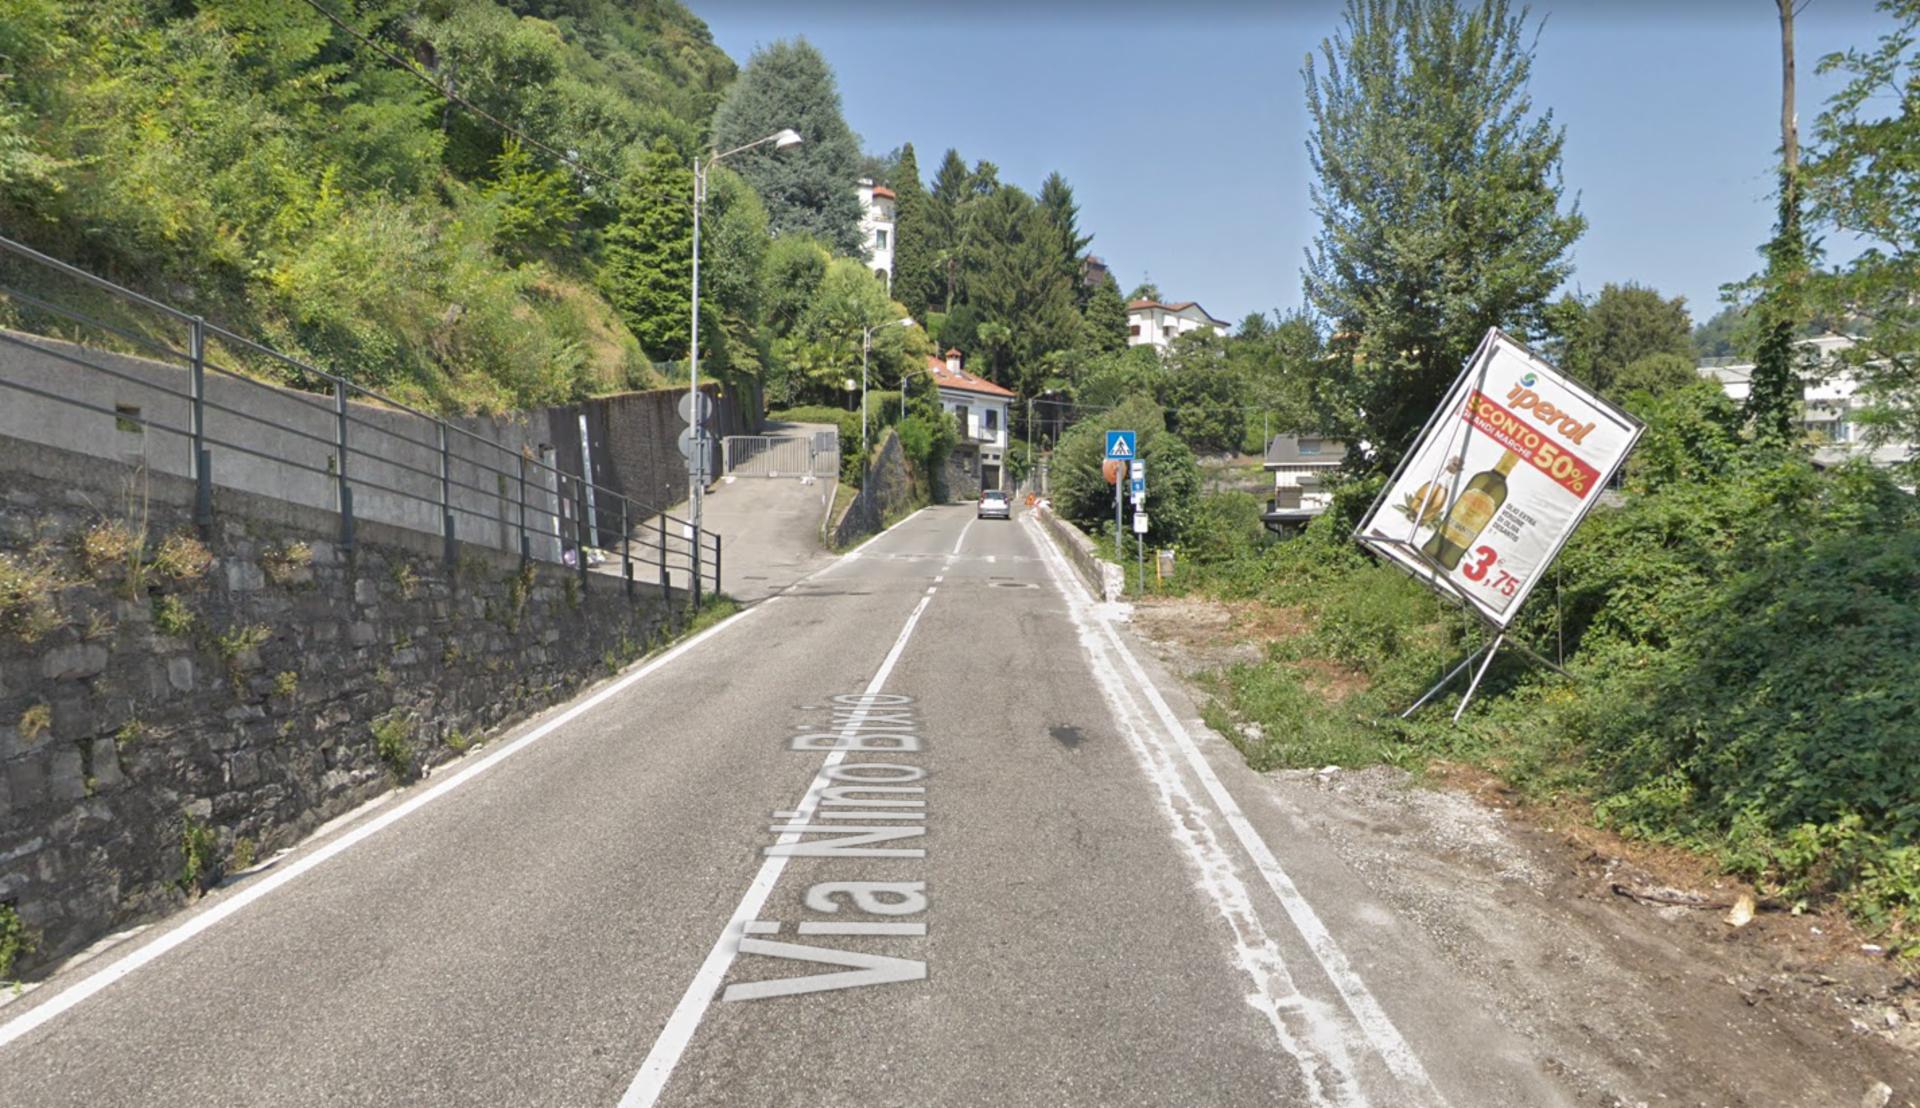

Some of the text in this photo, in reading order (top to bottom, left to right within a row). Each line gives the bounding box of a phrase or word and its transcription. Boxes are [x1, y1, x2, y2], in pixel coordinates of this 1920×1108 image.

[1507, 383, 1596, 446] iperal
[1468, 395, 1588, 492] SCONTO 50%
[1494, 429, 1533, 459] MARCHE
[1520, 511, 1537, 527] EXTRA
